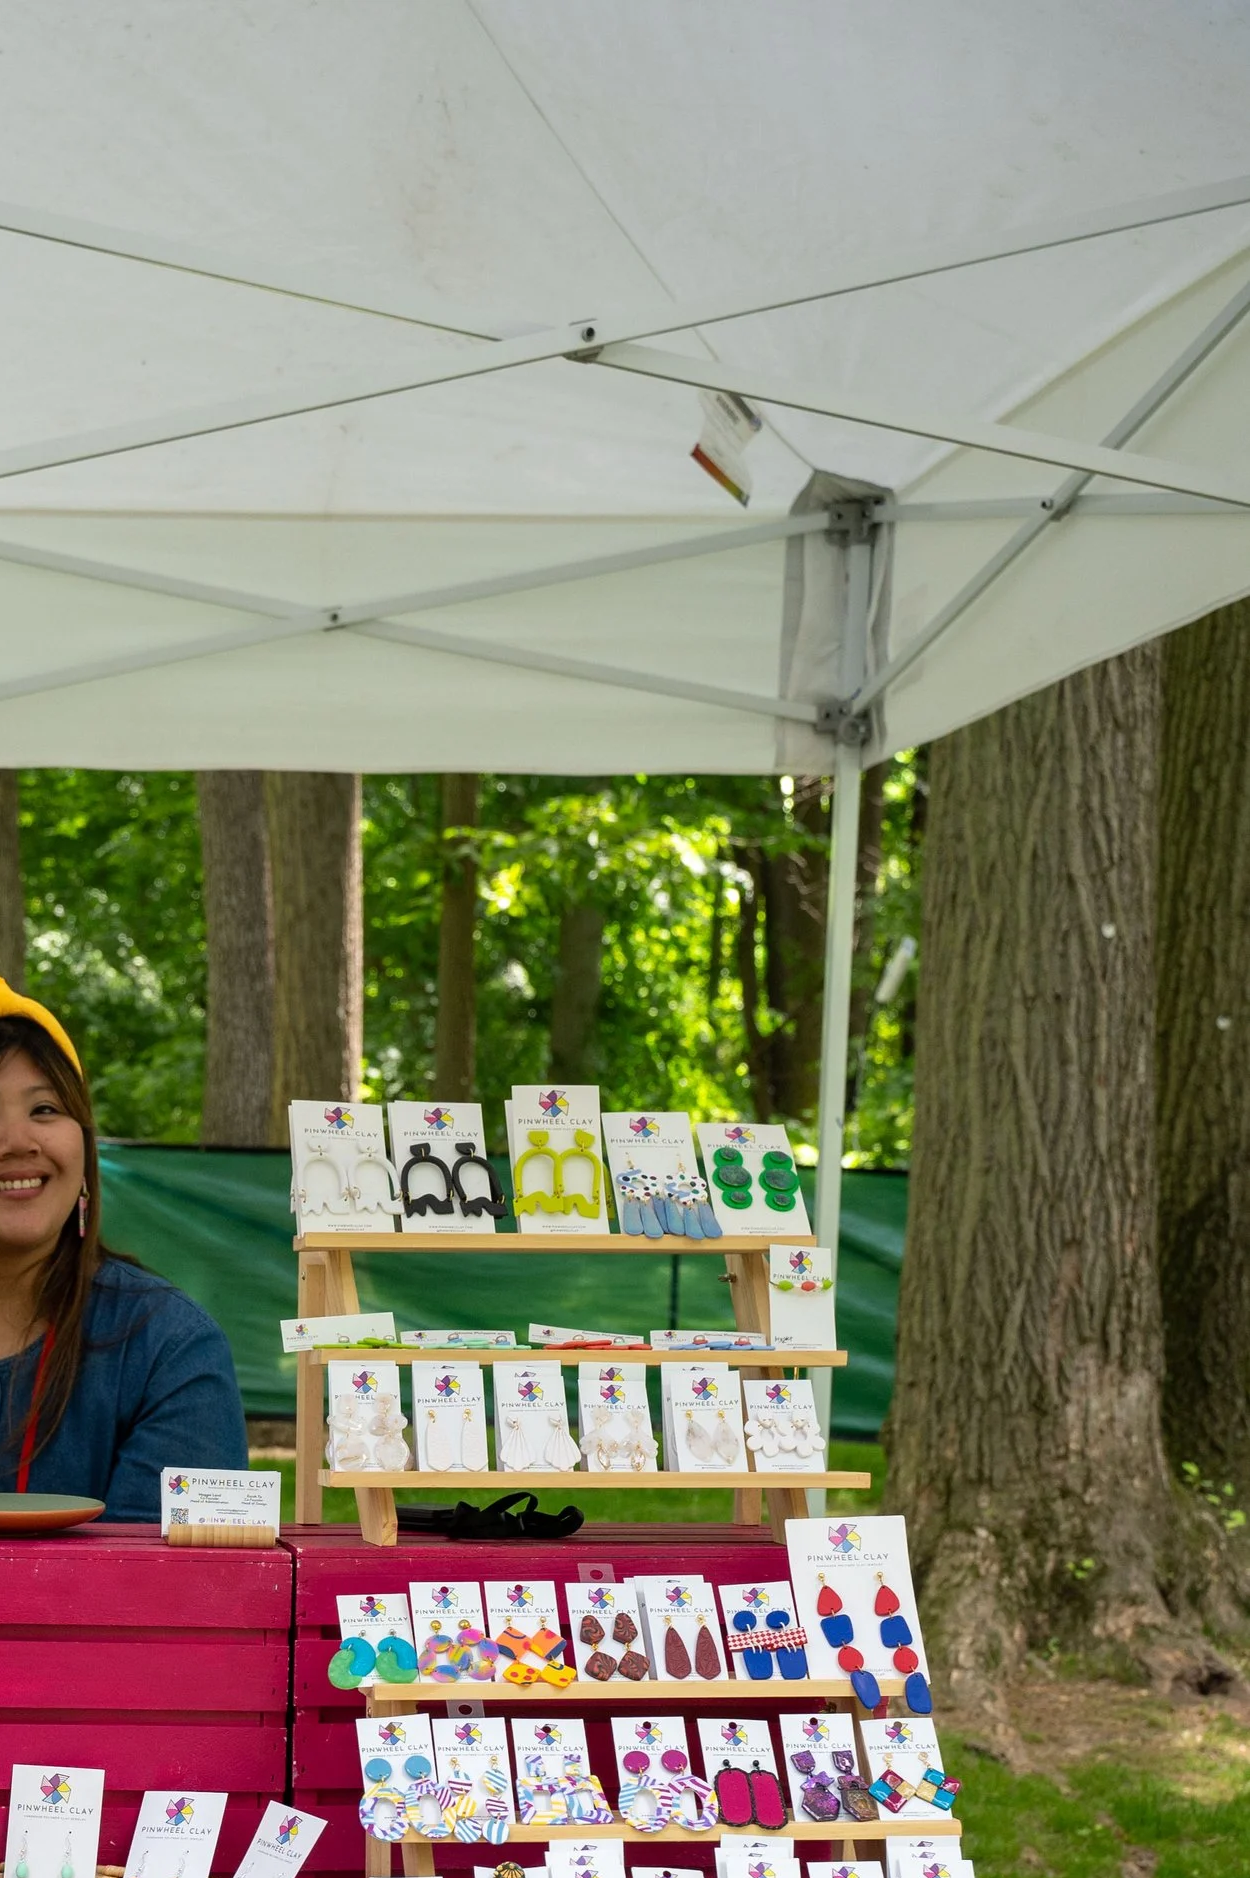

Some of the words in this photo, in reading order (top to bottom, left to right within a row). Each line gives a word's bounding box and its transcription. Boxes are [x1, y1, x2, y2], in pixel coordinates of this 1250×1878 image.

[304, 1128, 352, 1136] PINWHEEL
[192, 1478, 244, 1487] PINWHEEL
[249, 1480, 275, 1489] CLAY
[807, 1553, 859, 1562] PINWHEEL
[863, 1553, 889, 1561] CLAY
[17, 1804, 65, 1814] PINWHEEL
[69, 1807, 94, 1815] CLAY
[189, 1827, 212, 1835] CLAY
[256, 1838, 285, 1854] PINWHEEL
[286, 1848, 302, 1860] CLAY
